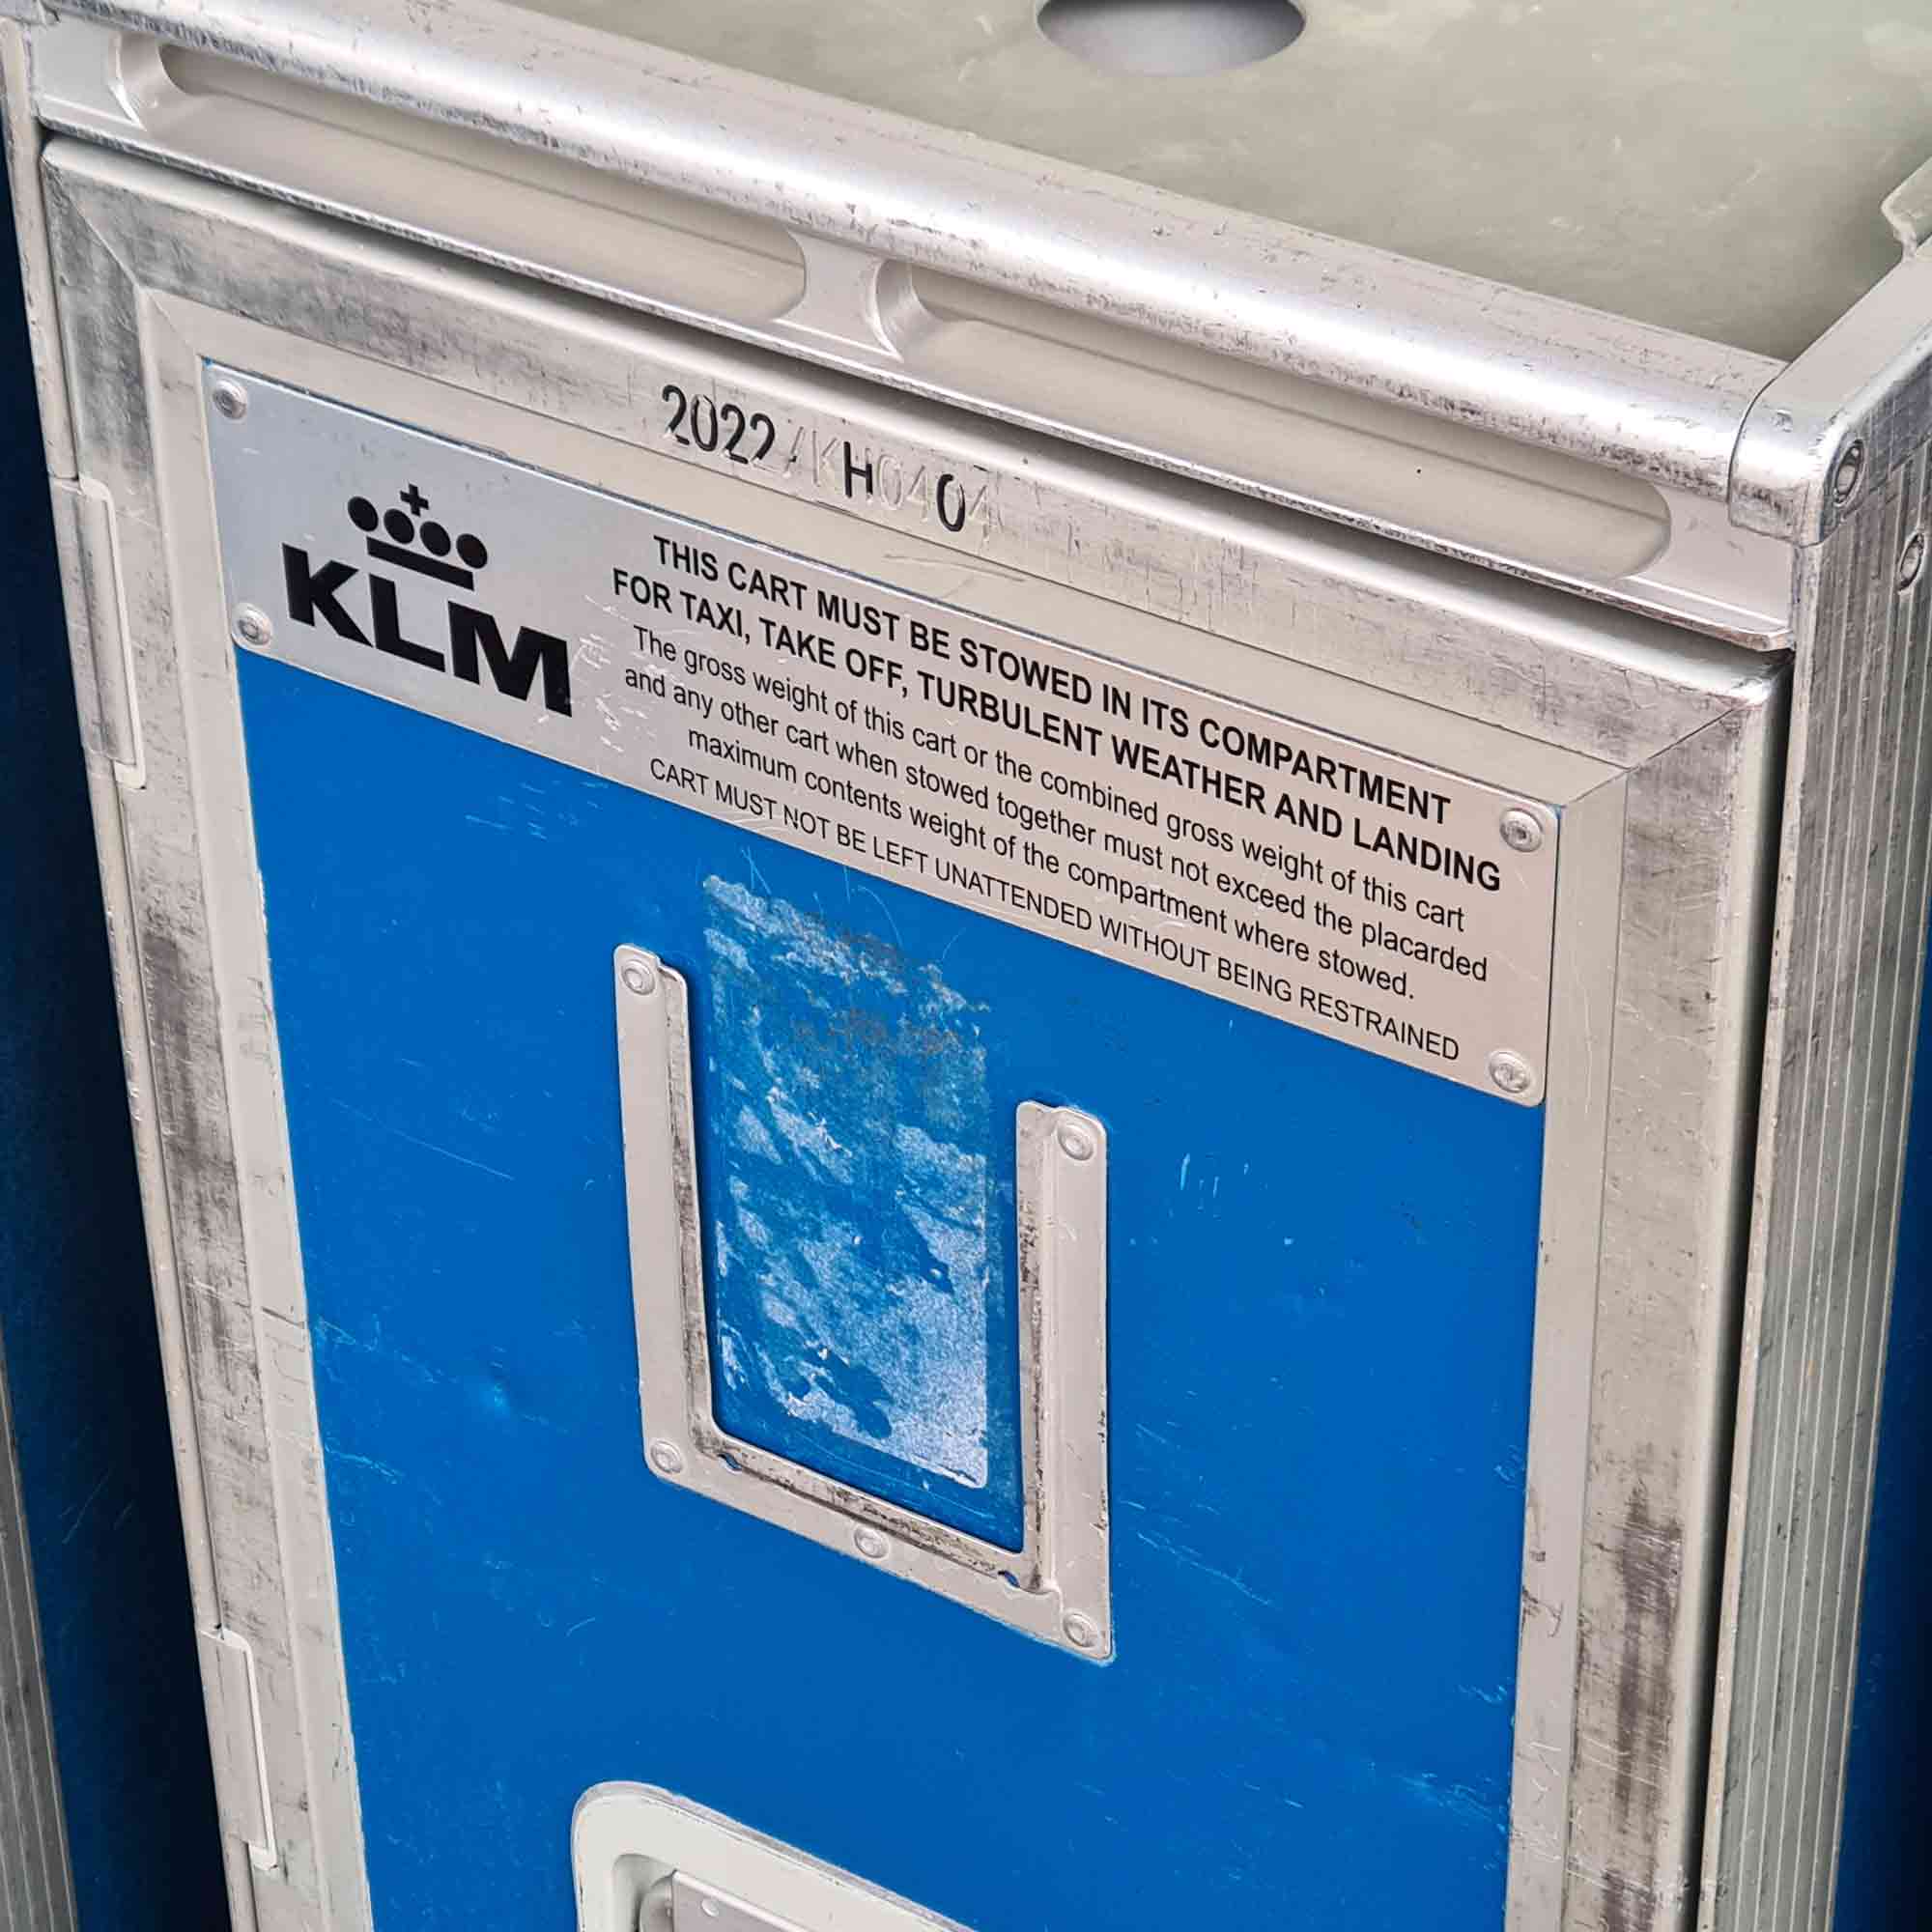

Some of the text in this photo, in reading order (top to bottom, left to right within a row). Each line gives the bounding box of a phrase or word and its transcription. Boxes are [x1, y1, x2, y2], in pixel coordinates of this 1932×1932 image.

[282, 543, 573, 717] KLM
[612, 567, 1500, 892] FOR TAXI, TAKE OFF, TURBULENT WEATHER AND LANDING
[633, 624, 1465, 933] The gross weight of this cart or the combined gross weight of this cart
[653, 534, 1452, 825] THIS CART MUST BE STOWED IN ITS COMPARTMENT
[625, 668, 1488, 982] and any other cart when stowed together must not exceed the placarded
[650, 757, 1460, 1061] CART MUST NOT BE LEFT UNATTENDED WITHOUT BEING RESTRAINED
[688, 728, 1414, 1000] maximum contents weight of the compartment where stowed.
